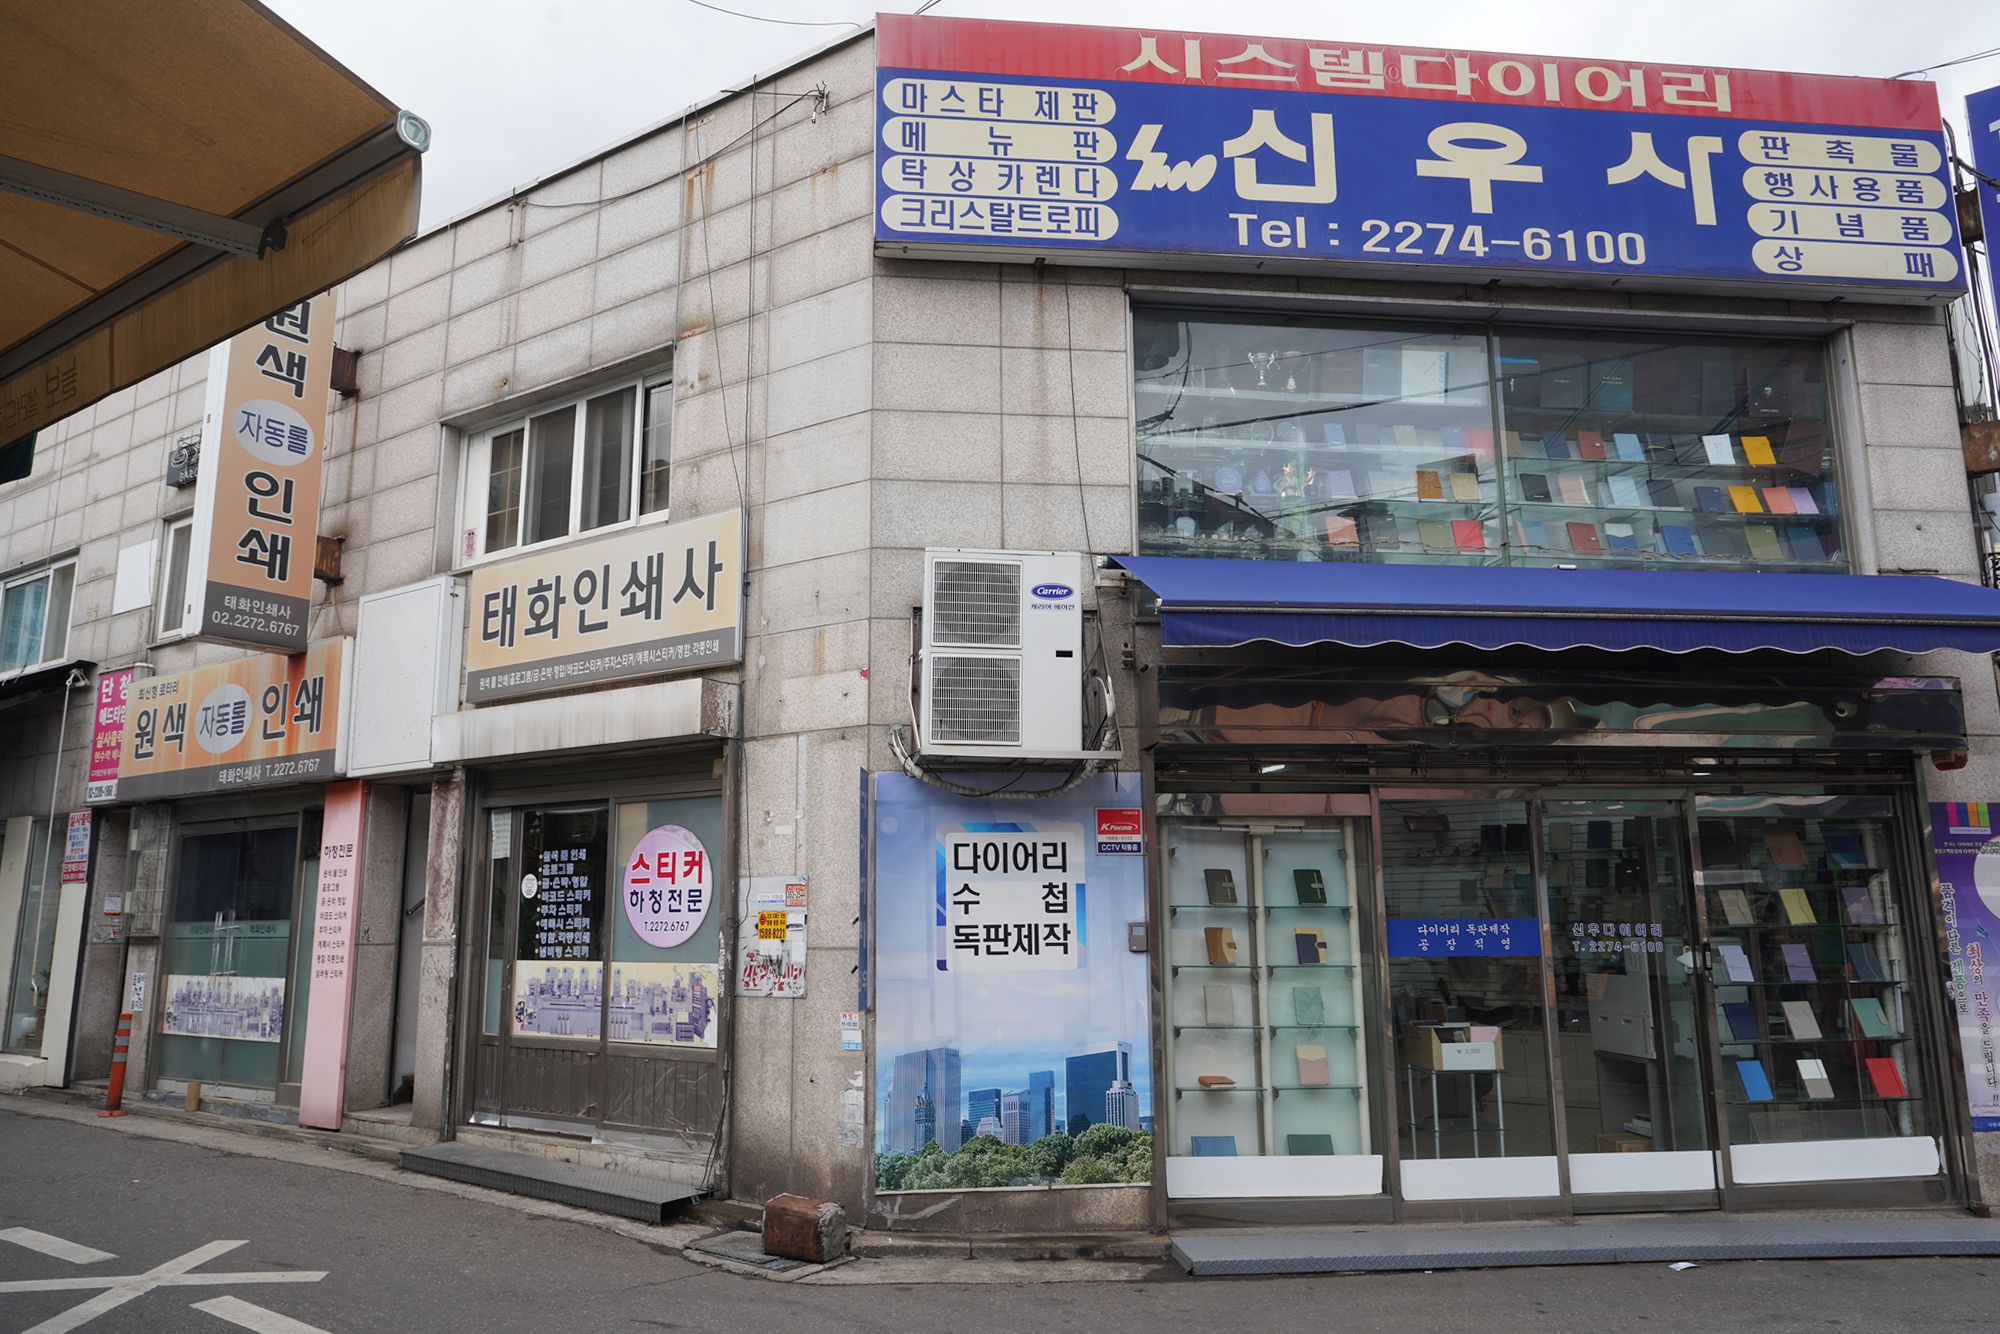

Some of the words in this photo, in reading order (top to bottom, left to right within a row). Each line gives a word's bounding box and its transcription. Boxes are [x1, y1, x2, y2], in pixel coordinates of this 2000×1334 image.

[1764, 171, 1924, 205] 행사용품
[900, 197, 1100, 238] 크리스탈트로피
[1361, 219, 1647, 266] 2274-6100
[238, 408, 309, 457] 자동롤
[236, 470, 296, 583] 인쇄
[481, 540, 724, 649] 태화인쇄사
[1036, 586, 1069, 595] Carrier
[211, 610, 300, 636] 02.2272.6767
[223, 595, 292, 620] 태화인쇄사
[199, 700, 247, 739] 자동롤
[261, 676, 325, 741] 인쇄
[134, 701, 189, 760] 원색
[218, 768, 262, 784] 태화인쇄사
[324, 844, 353, 860] 하청전문
[953, 841, 1068, 874] 다이어리
[1121, 843, 1138, 852] 작동중
[542, 863, 574, 876] 홀로그램
[629, 850, 704, 885] 스티커
[629, 888, 703, 914] 하청전문
[643, 920, 690, 933] T.2272.6767
[953, 922, 1071, 956] 독판제작
[1417, 923, 1461, 937] 다이어리
